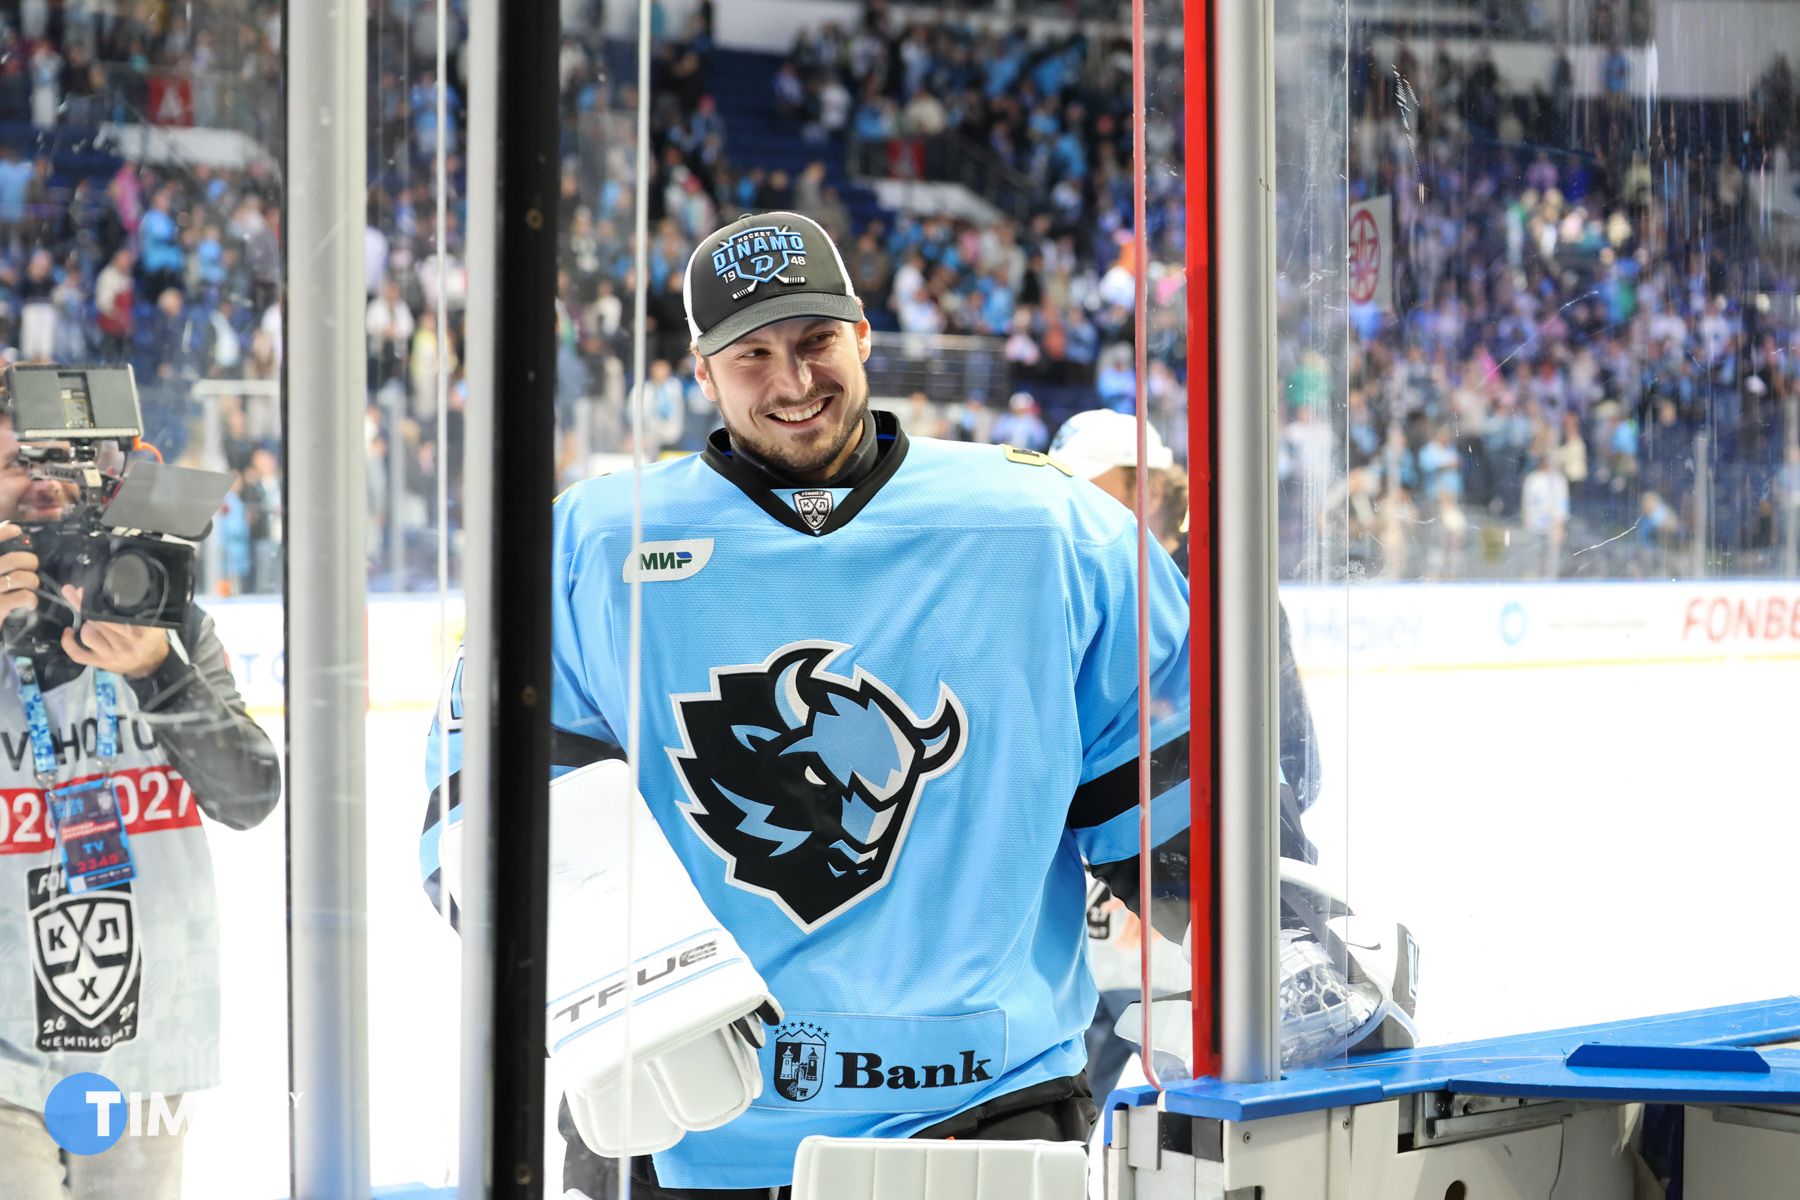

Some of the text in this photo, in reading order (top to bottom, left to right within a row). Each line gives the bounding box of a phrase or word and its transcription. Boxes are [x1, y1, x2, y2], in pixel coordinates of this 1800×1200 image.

[737, 231, 772, 244] HOCKEY
[713, 235, 805, 271] DINAMO
[790, 255, 806, 266] 48
[722, 269, 737, 284] 19
[640, 552, 693, 571] МИР
[51, 714, 159, 766] HOTO
[43, 1015, 68, 1035] 26
[834, 1050, 993, 1090] Bank
